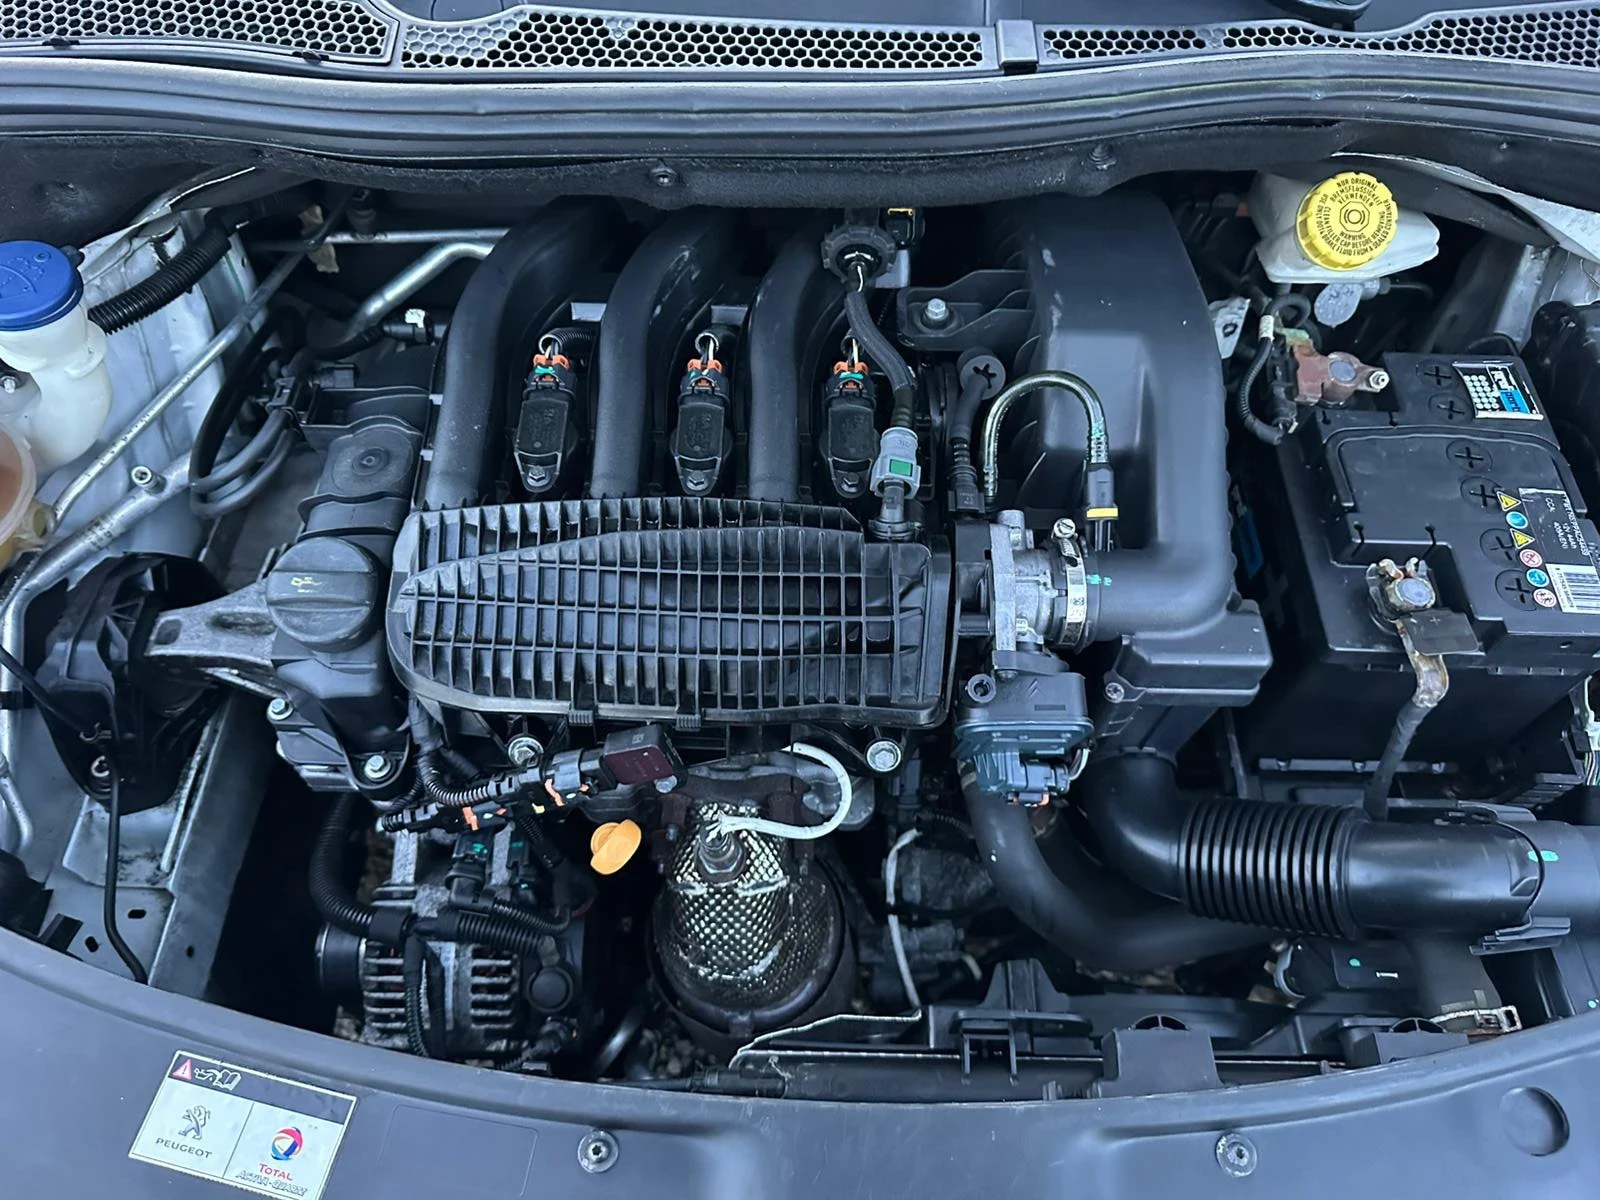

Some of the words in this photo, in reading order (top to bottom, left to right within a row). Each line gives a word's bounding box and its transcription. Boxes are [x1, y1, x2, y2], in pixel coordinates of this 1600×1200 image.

[1336, 178, 1349, 188] NUR
[1350, 177, 1378, 191] ORIGINAL
[1319, 193, 1329, 205] USE
[1337, 192, 1374, 207] VERWENDEN
[1315, 204, 1324, 219] ONLY
[1323, 206, 1331, 225] CLEAN
[1382, 198, 1393, 231] CONTAINER
[1371, 210, 1386, 239] REMOVING
[1325, 224, 1340, 244] FILLER
[1339, 231, 1367, 240] WARNING
[1372, 231, 1389, 249] SEALED
[1321, 234, 1338, 251] BRAKE
[1340, 239, 1351, 248] CAP
[1351, 236, 1372, 249] BEFORE
[1336, 246, 1353, 256] FLUID
[1353, 247, 1370, 256] FROM
[156, 1137, 212, 1159] PEUGEOT
[259, 1163, 293, 1181] TOTAL
